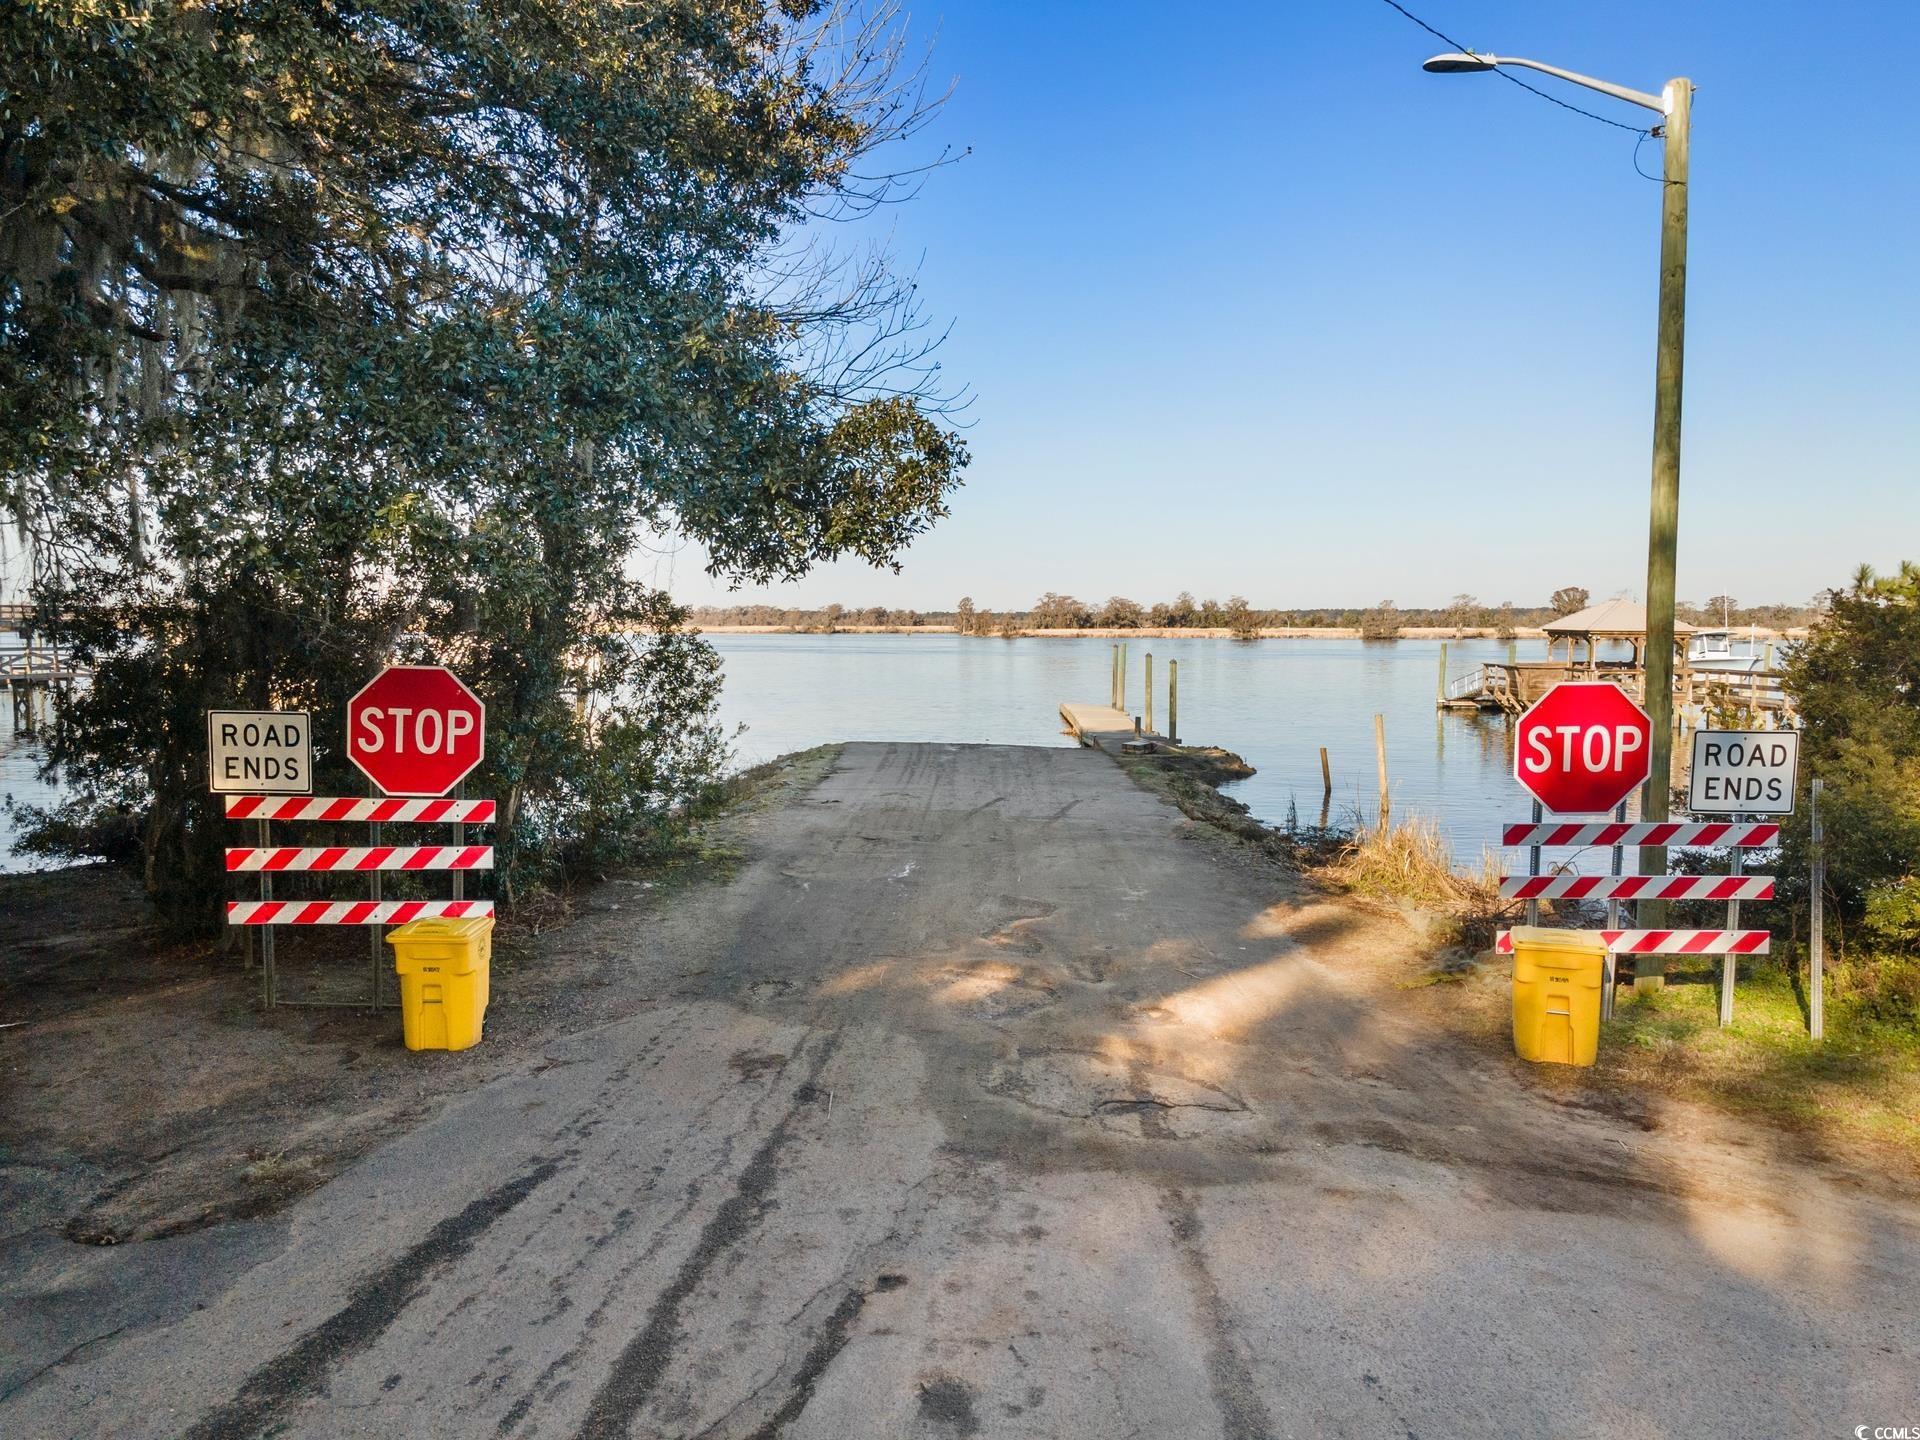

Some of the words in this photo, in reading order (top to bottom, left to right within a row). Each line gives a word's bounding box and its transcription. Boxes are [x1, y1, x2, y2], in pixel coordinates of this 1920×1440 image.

[221, 723, 301, 748] ROAD
[357, 706, 474, 755] STOP
[1524, 724, 1642, 774] STOP
[1704, 743, 1787, 767] ROAD
[225, 756, 299, 781] ENDS
[1704, 776, 1782, 801] ENDS
